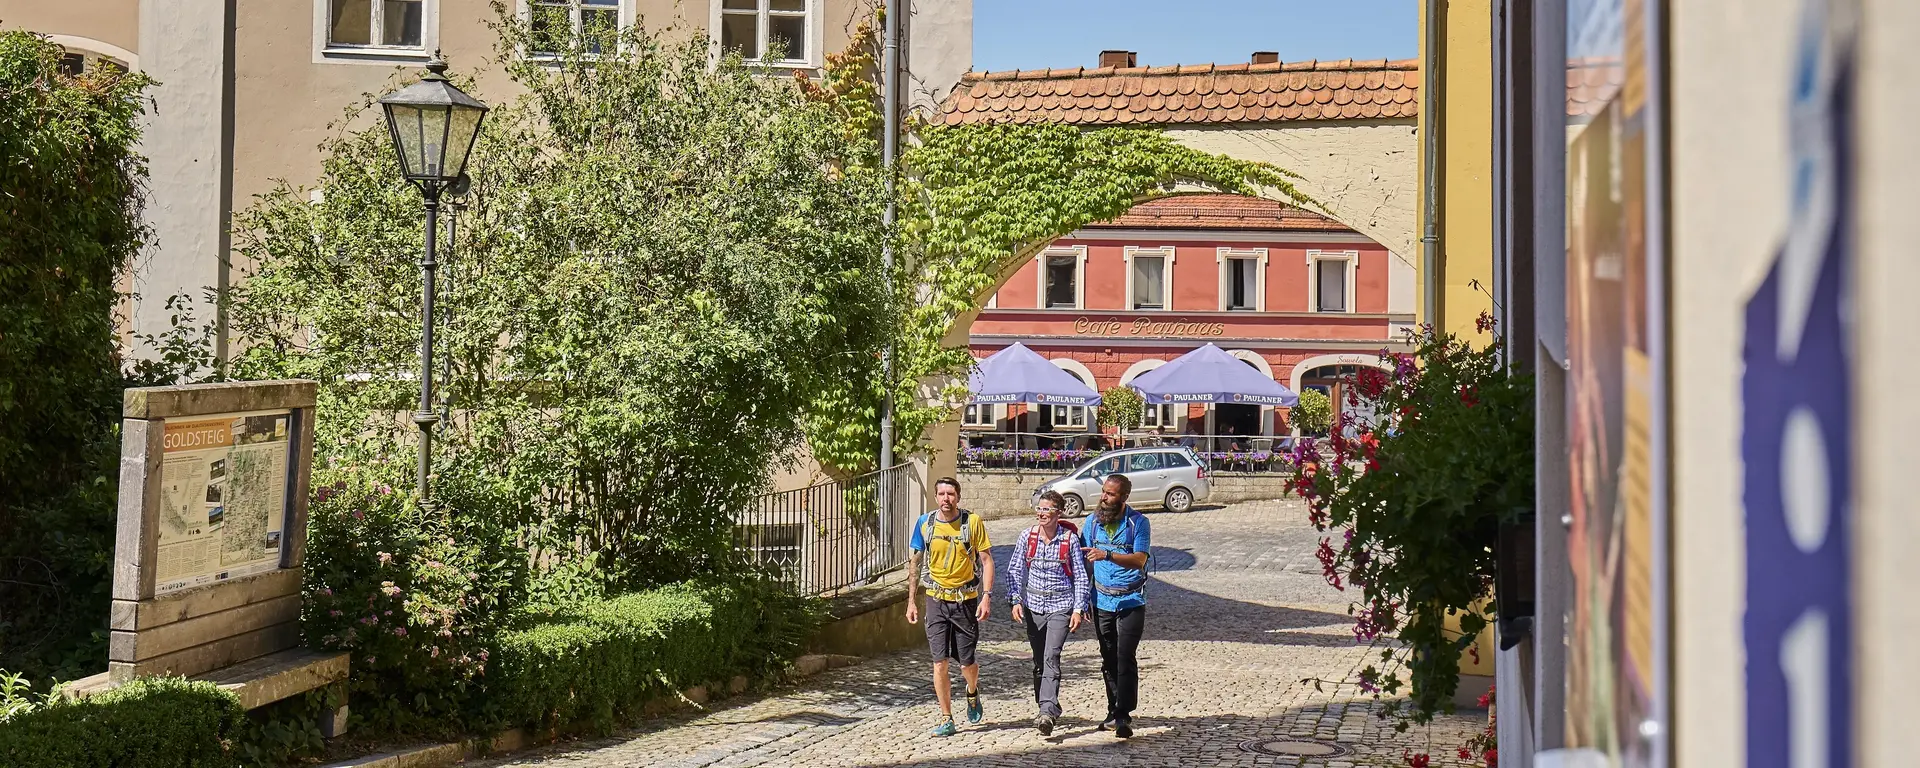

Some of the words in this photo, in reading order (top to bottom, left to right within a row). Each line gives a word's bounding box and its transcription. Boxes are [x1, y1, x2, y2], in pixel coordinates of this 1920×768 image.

[1129, 316, 1225, 336] Rathaus
[977, 393, 1017, 402] PAULANER
[1046, 395, 1085, 404] PAULANER
[1173, 393, 1214, 402] PAULANER
[1242, 394, 1283, 404] PAULANER
[163, 428, 225, 449] GOLDSTEIG
